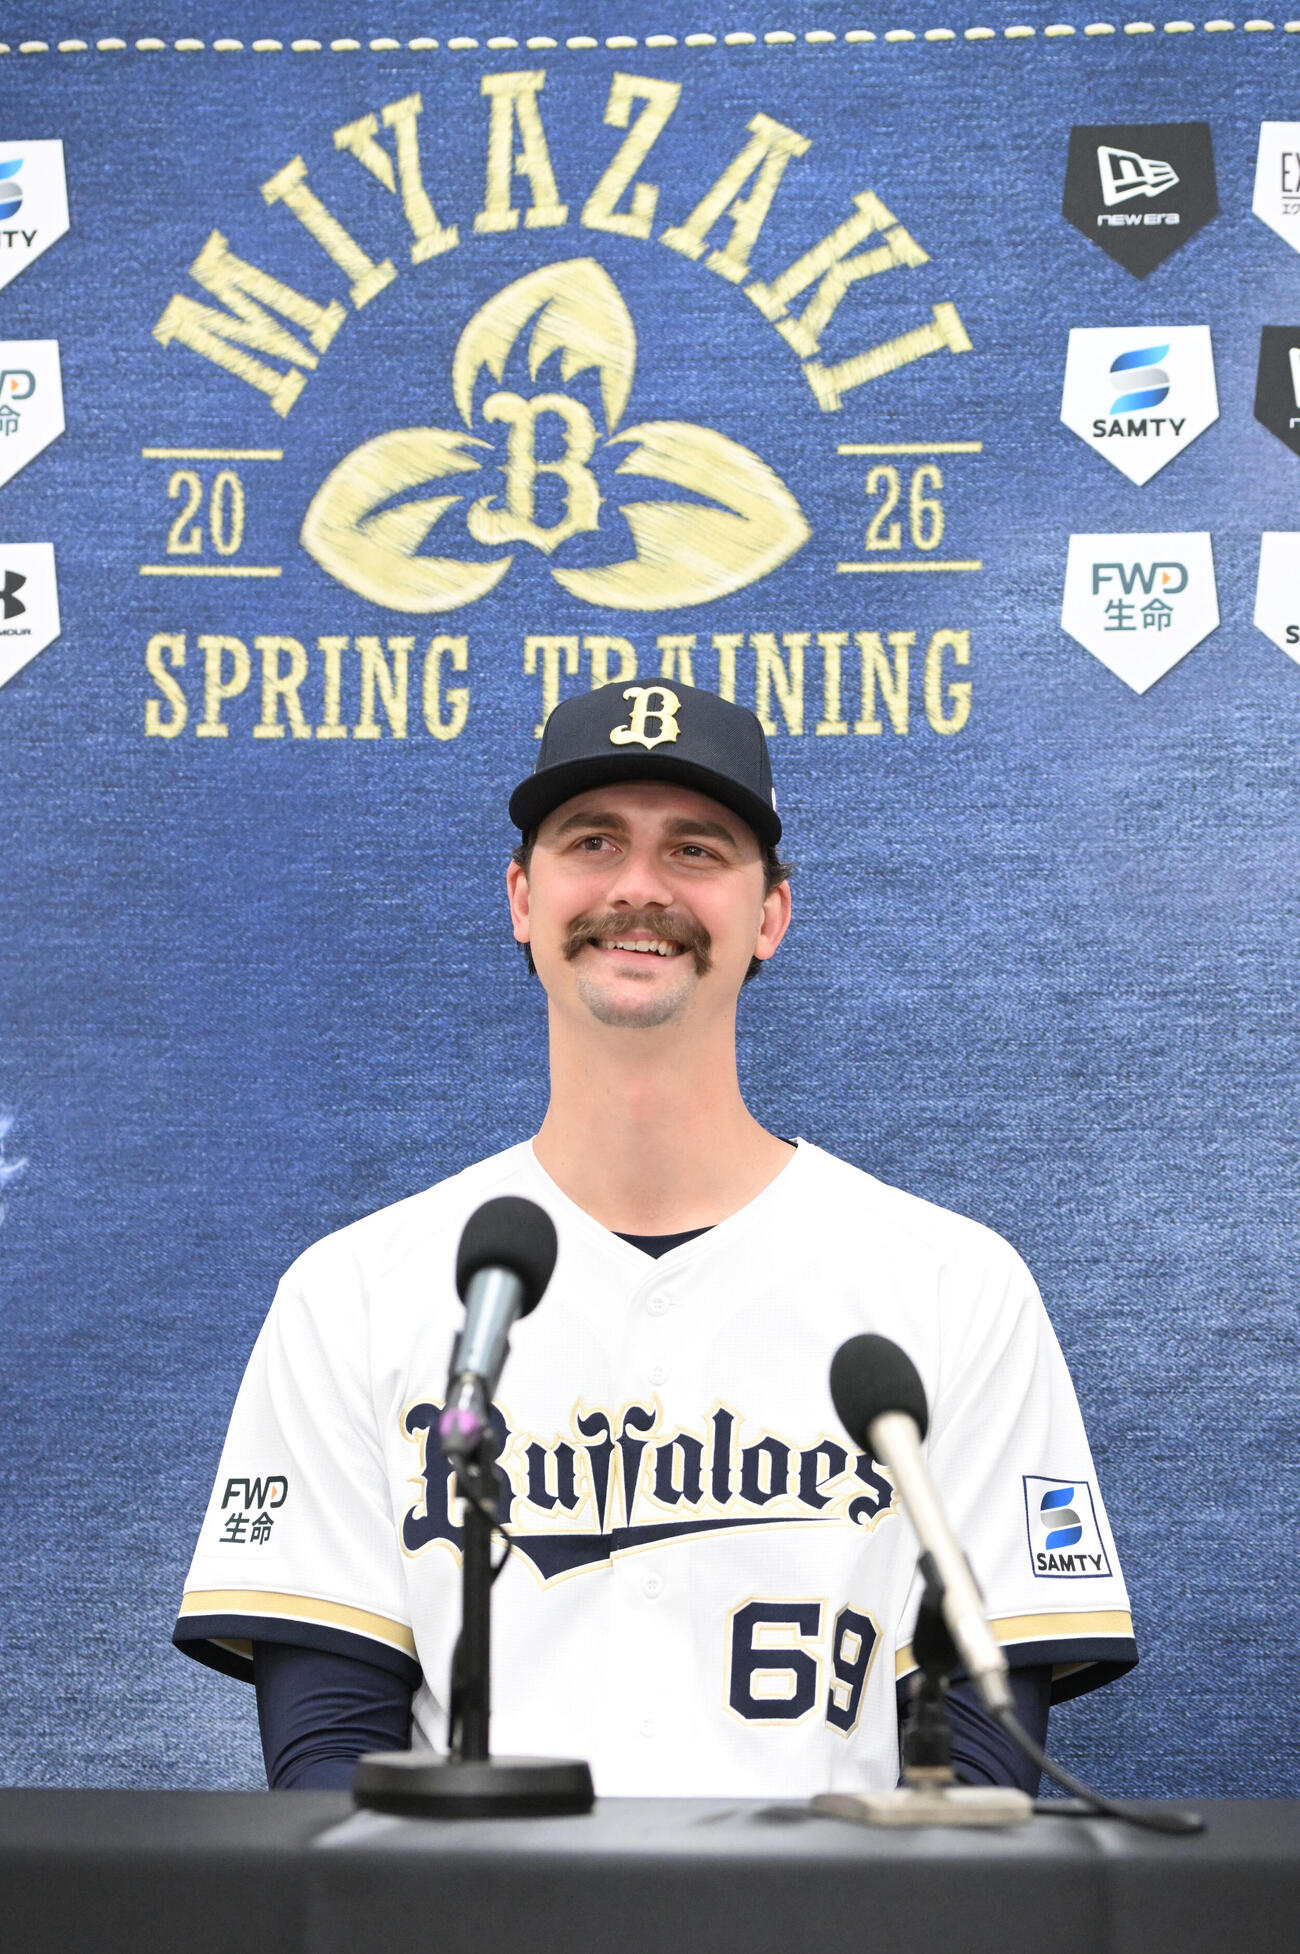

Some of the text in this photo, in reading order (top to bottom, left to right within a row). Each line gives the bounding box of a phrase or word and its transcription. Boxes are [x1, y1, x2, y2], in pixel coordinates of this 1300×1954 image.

[152, 69, 973, 418] MIYAZAKI
[1092, 418, 1186, 438] SAMTY
[466, 391, 607, 556] B
[166, 470, 245, 556] 20
[864, 464, 946, 552] 26
[1092, 562, 1188, 595] FWD
[1103, 598, 1175, 632] 生命
[144, 634, 469, 741] SPRING
[609, 686, 682, 750] B
[220, 1475, 289, 1509] FWD
[219, 1511, 275, 1545] 生命
[1037, 1552, 1103, 1573] SAMTY
[723, 1596, 883, 1740] 69
